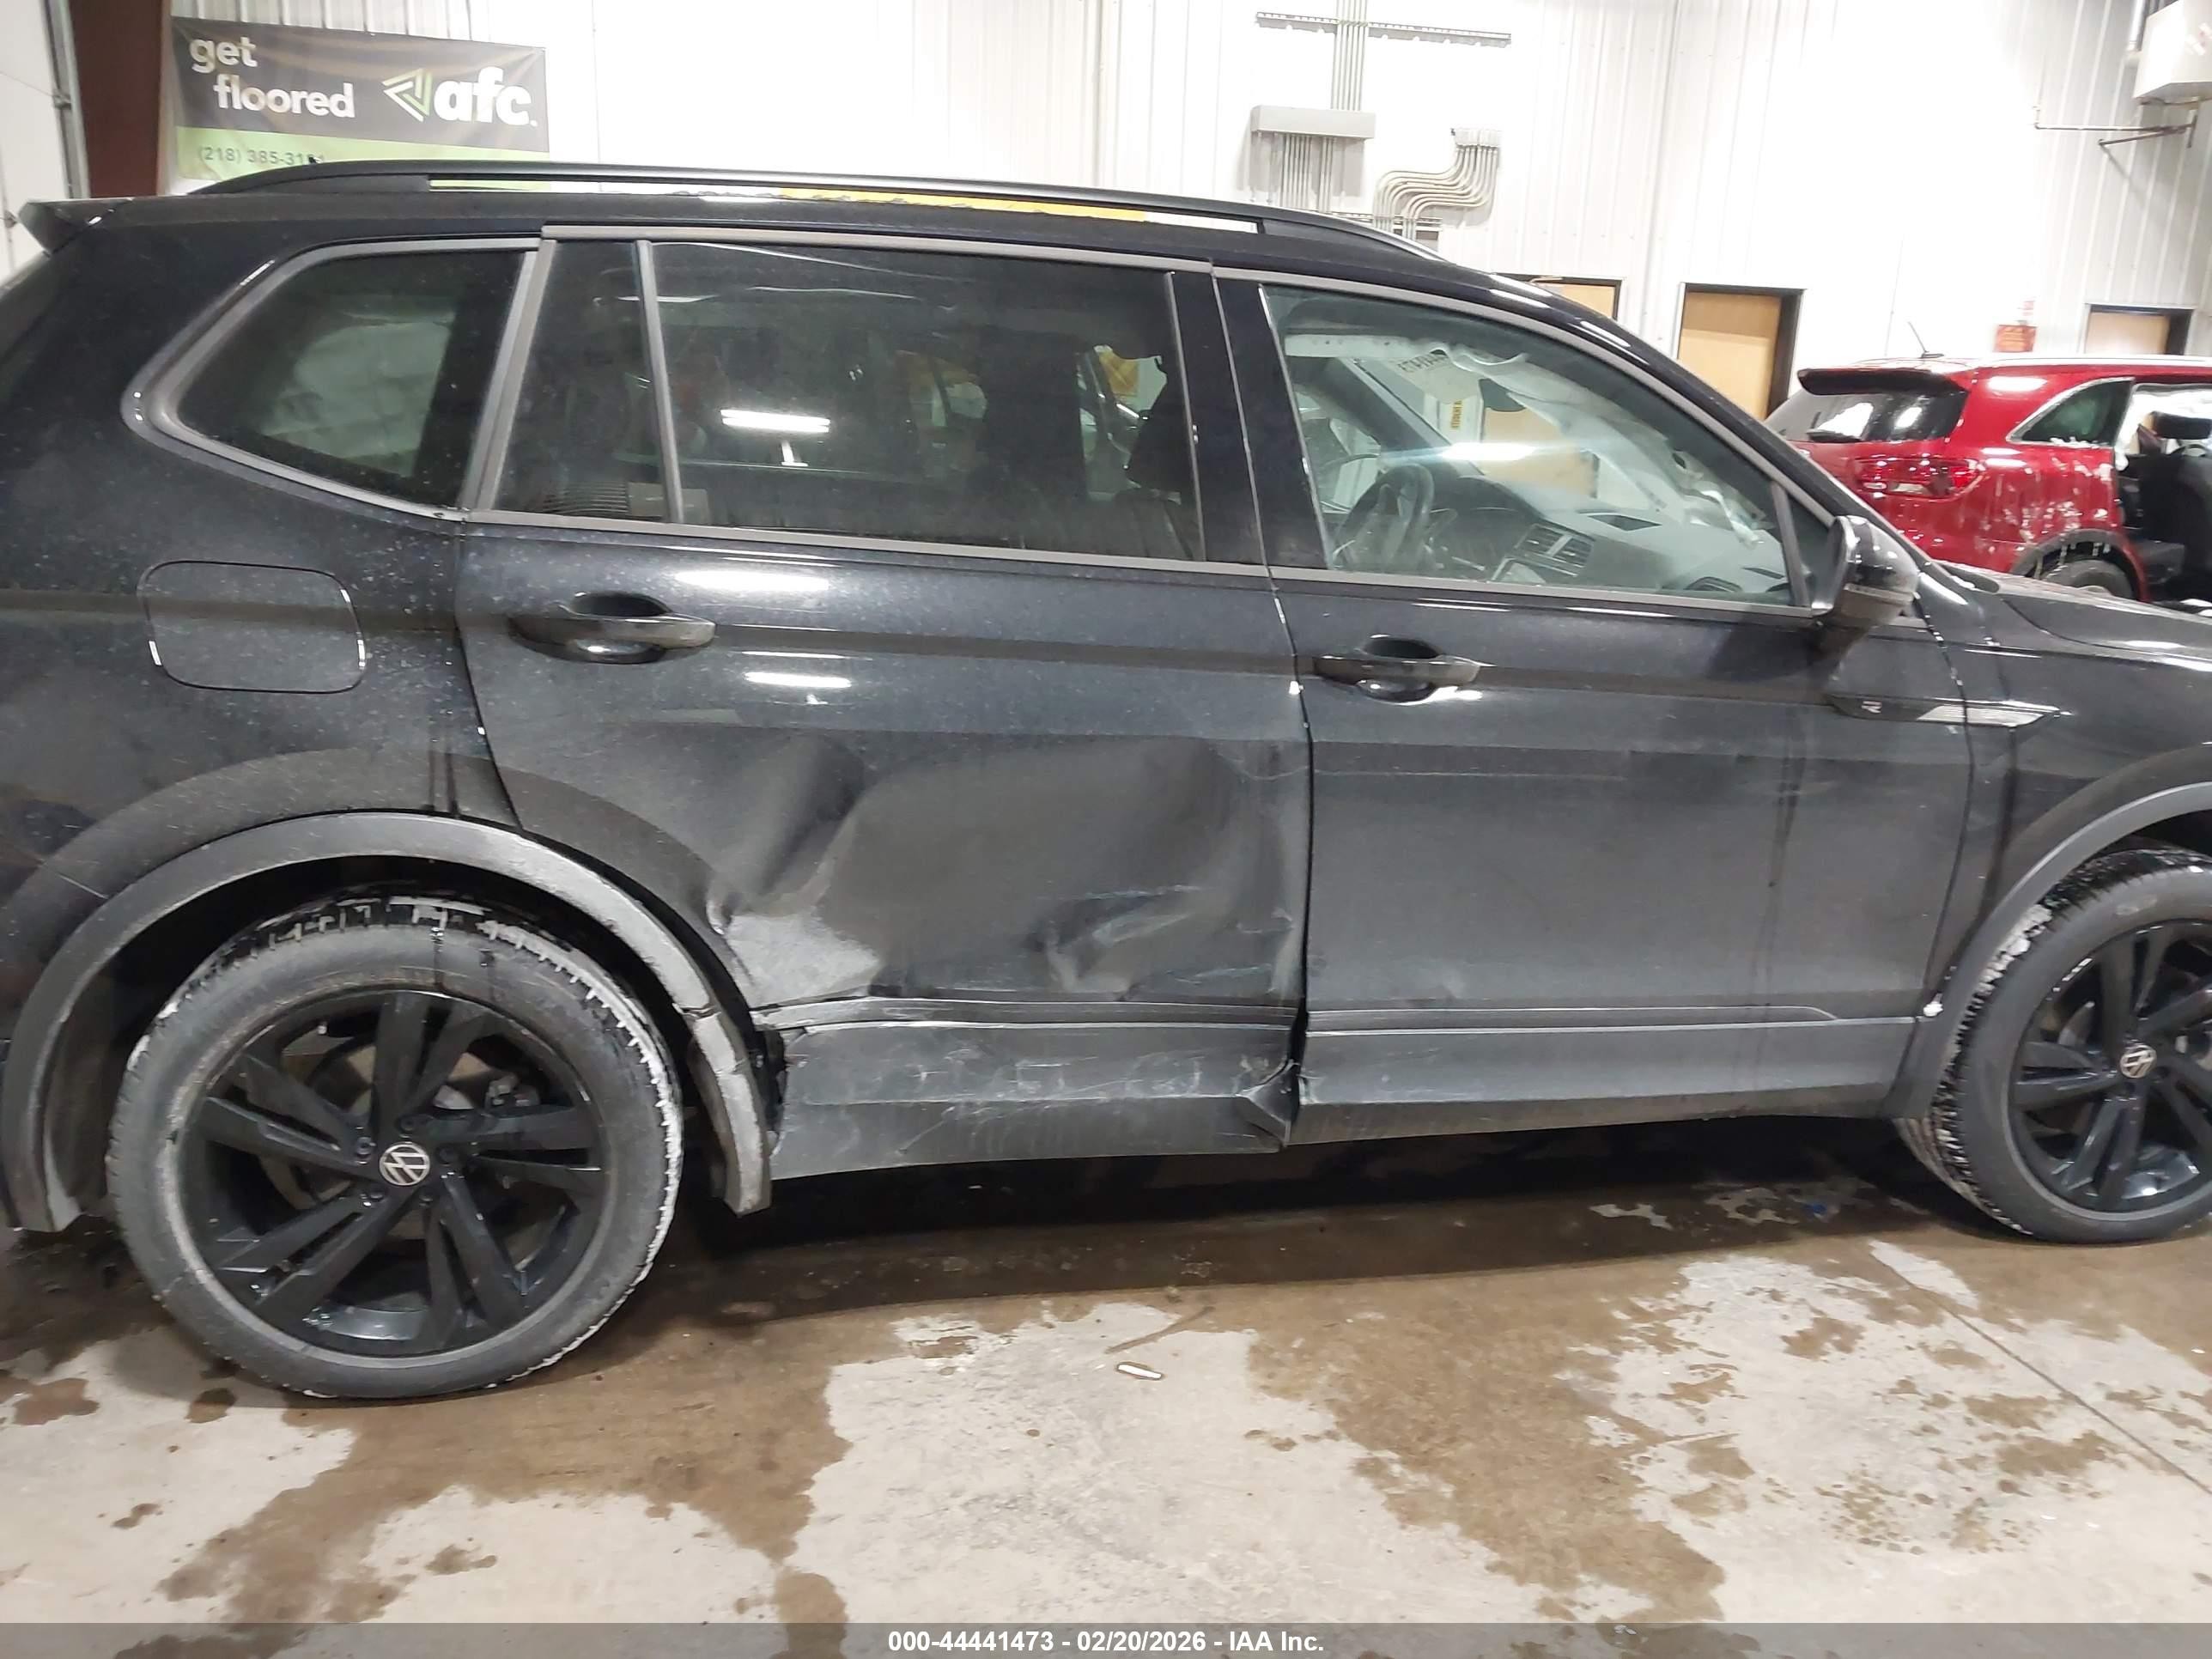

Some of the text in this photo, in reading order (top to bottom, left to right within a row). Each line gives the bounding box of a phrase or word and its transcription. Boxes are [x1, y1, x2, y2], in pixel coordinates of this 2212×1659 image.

[188, 36, 258, 74] get
[213, 73, 356, 119] floored
[198, 145, 325, 166] (218) 385-31
